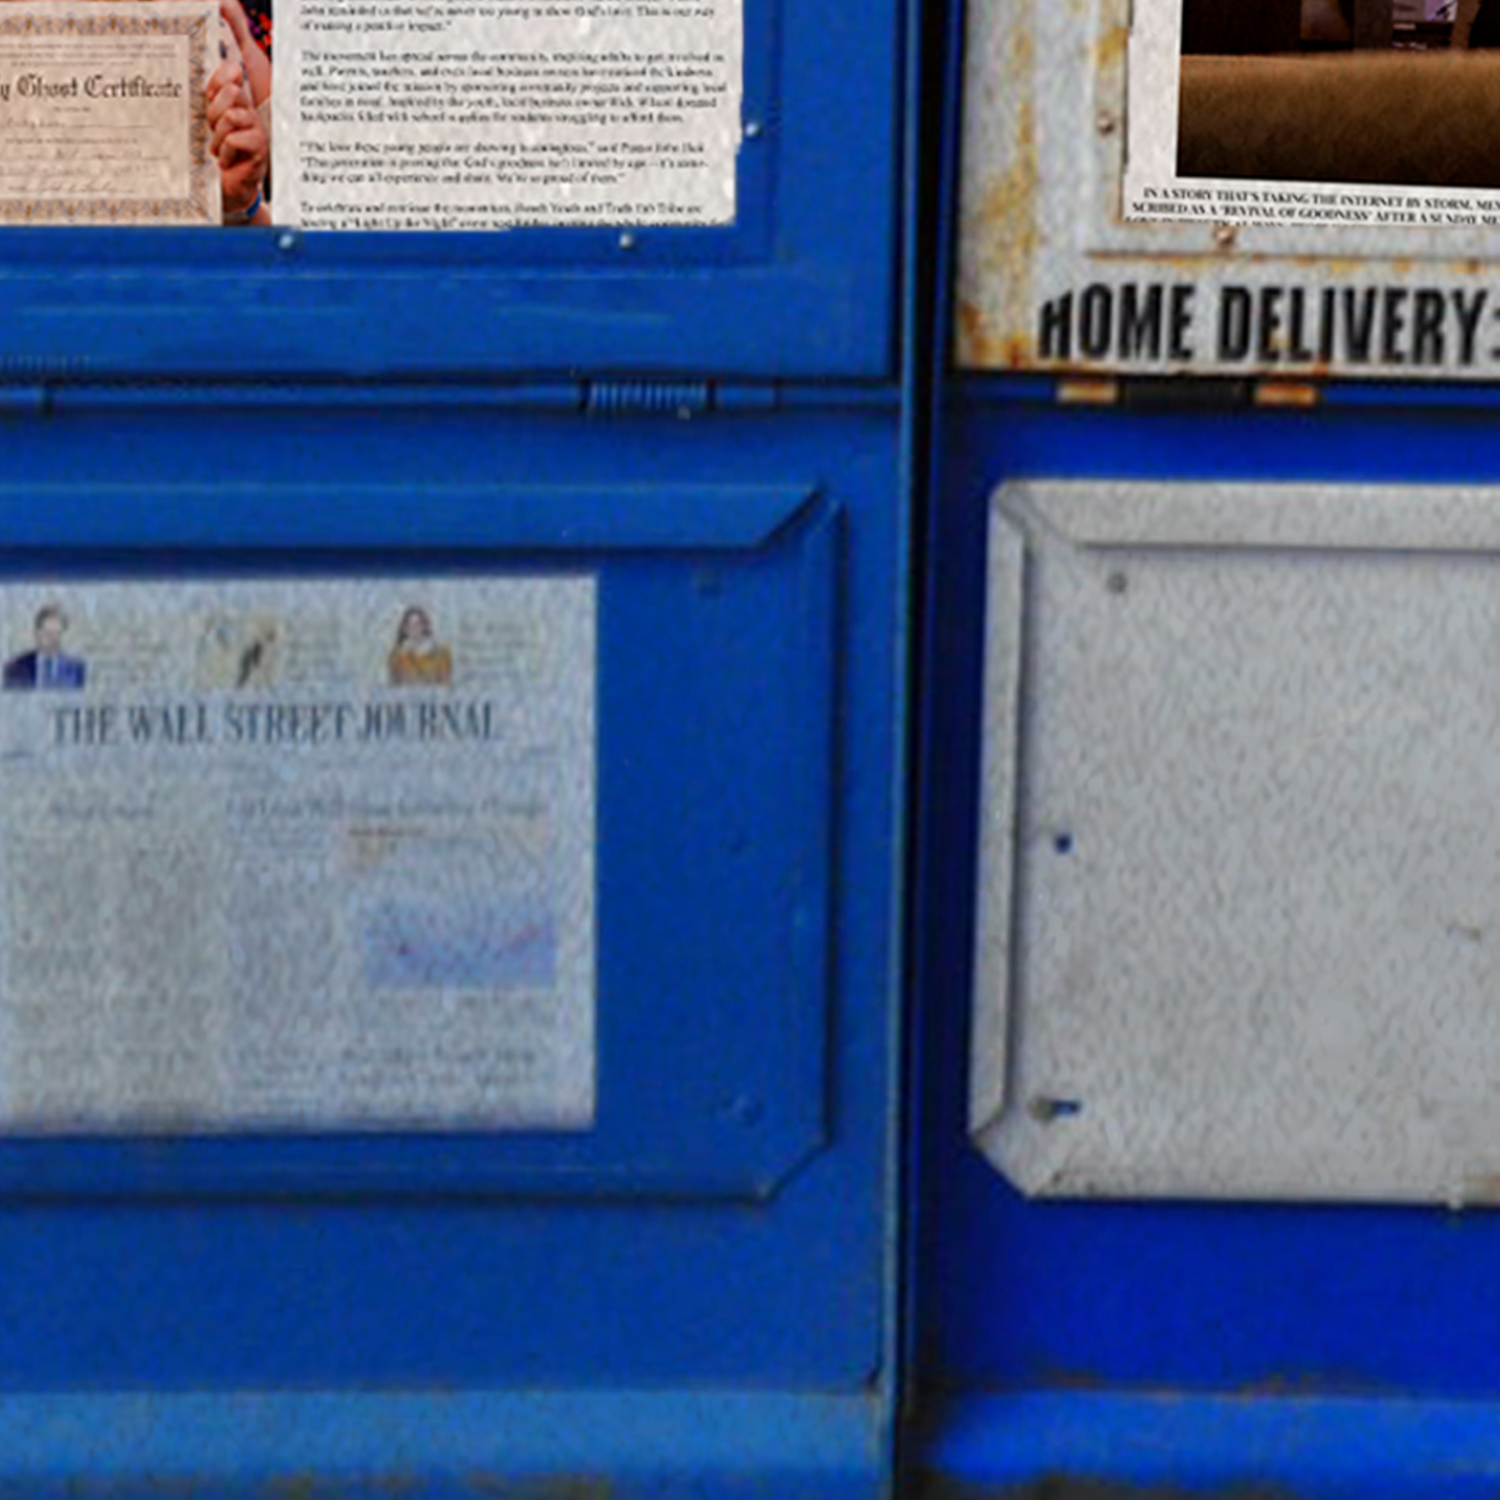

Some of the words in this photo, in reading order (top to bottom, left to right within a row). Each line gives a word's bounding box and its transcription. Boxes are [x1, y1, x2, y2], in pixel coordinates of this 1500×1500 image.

[17, 73, 79, 99] Ghost
[83, 74, 182, 99] Certificate
[1143, 187, 1157, 199] IN
[1163, 189, 1170, 200] A
[1172, 189, 1212, 201] STORY
[1216, 190, 1259, 202] THAT'S
[1262, 192, 1309, 204] TAKING
[1312, 194, 1337, 206] THE
[1340, 195, 1403, 208] INTERNET
[1406, 197, 1421, 209] BY
[1132, 202, 1188, 215] SCRIBED
[1191, 204, 1206, 216] AS
[1210, 205, 1218, 217] A
[1278, 207, 1296, 219] OF
[1376, 212, 1417, 224] AFTER
[1421, 213, 1428, 224] A
[1430, 214, 1477, 225] SUNDAY
[1038, 282, 1196, 361] HOME
[51, 702, 122, 746] THE
[130, 702, 212, 746] WALL
[224, 702, 356, 746] STREET
[360, 702, 499, 746] JOURNAL
